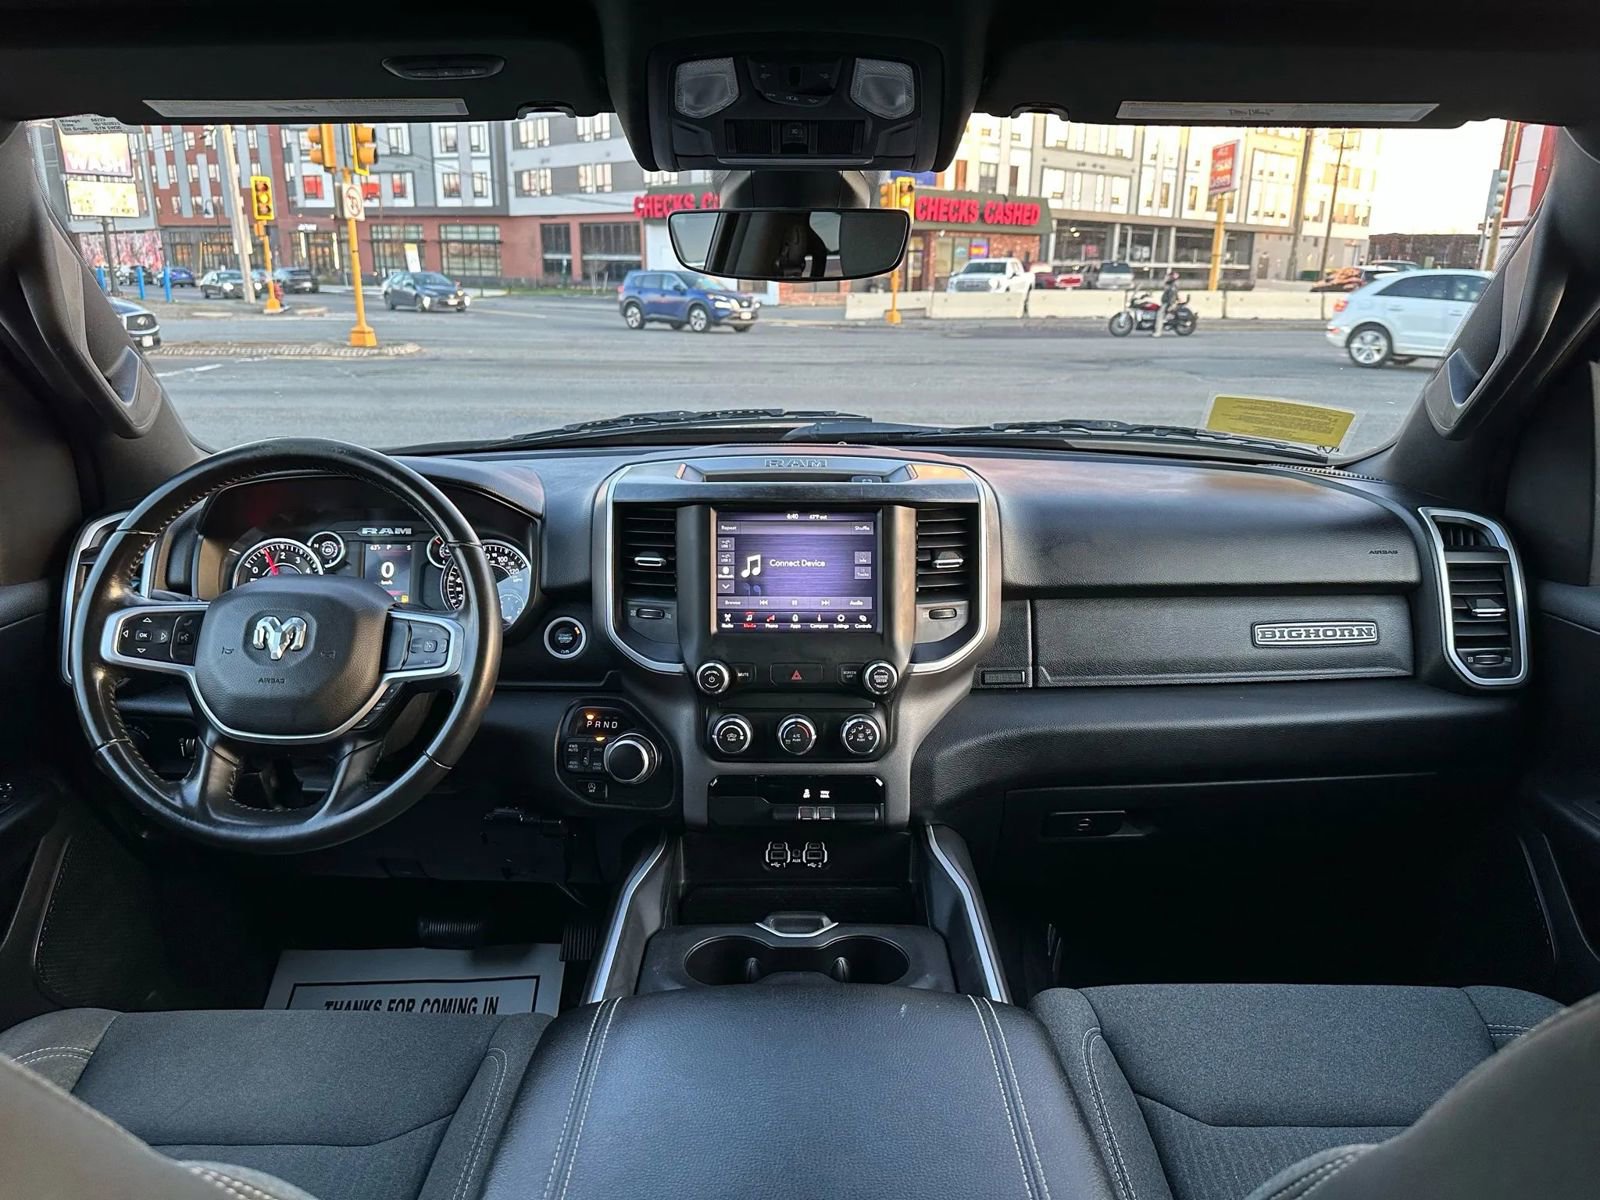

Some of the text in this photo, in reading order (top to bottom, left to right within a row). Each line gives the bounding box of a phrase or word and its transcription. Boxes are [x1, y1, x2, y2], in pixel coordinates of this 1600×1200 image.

[66, 153, 127, 173] WASH
[633, 193, 696, 219] CHECKS
[915, 195, 1040, 225] CHECKS CASHED
[765, 457, 828, 467] RAM
[361, 527, 412, 535] RAM
[381, 561, 395, 578] 0
[769, 559, 826, 567] Connect Device
[1257, 626, 1376, 640] BIGHORN
[324, 995, 500, 1015] THANKS FOR COMING IN
